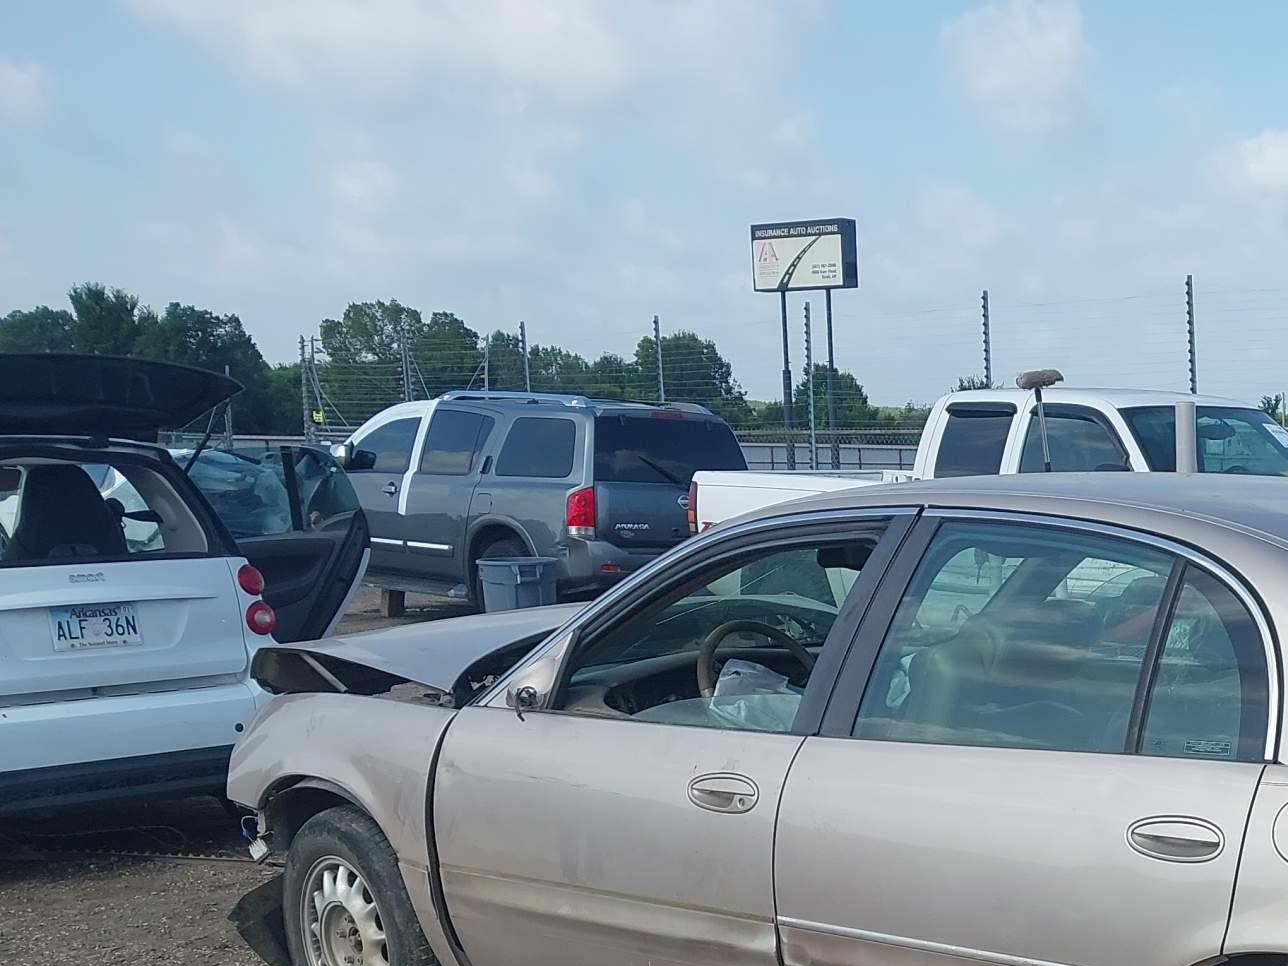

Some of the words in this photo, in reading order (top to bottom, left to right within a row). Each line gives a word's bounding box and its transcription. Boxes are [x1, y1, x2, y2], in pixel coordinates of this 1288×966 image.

[755, 228, 789, 237] INSURANCE
[790, 226, 806, 235] AUTO
[807, 224, 839, 234] AUCTIONS
[70, 607, 119, 619] Arkansas
[57, 619, 88, 641] ALF
[102, 615, 138, 637] 36N
